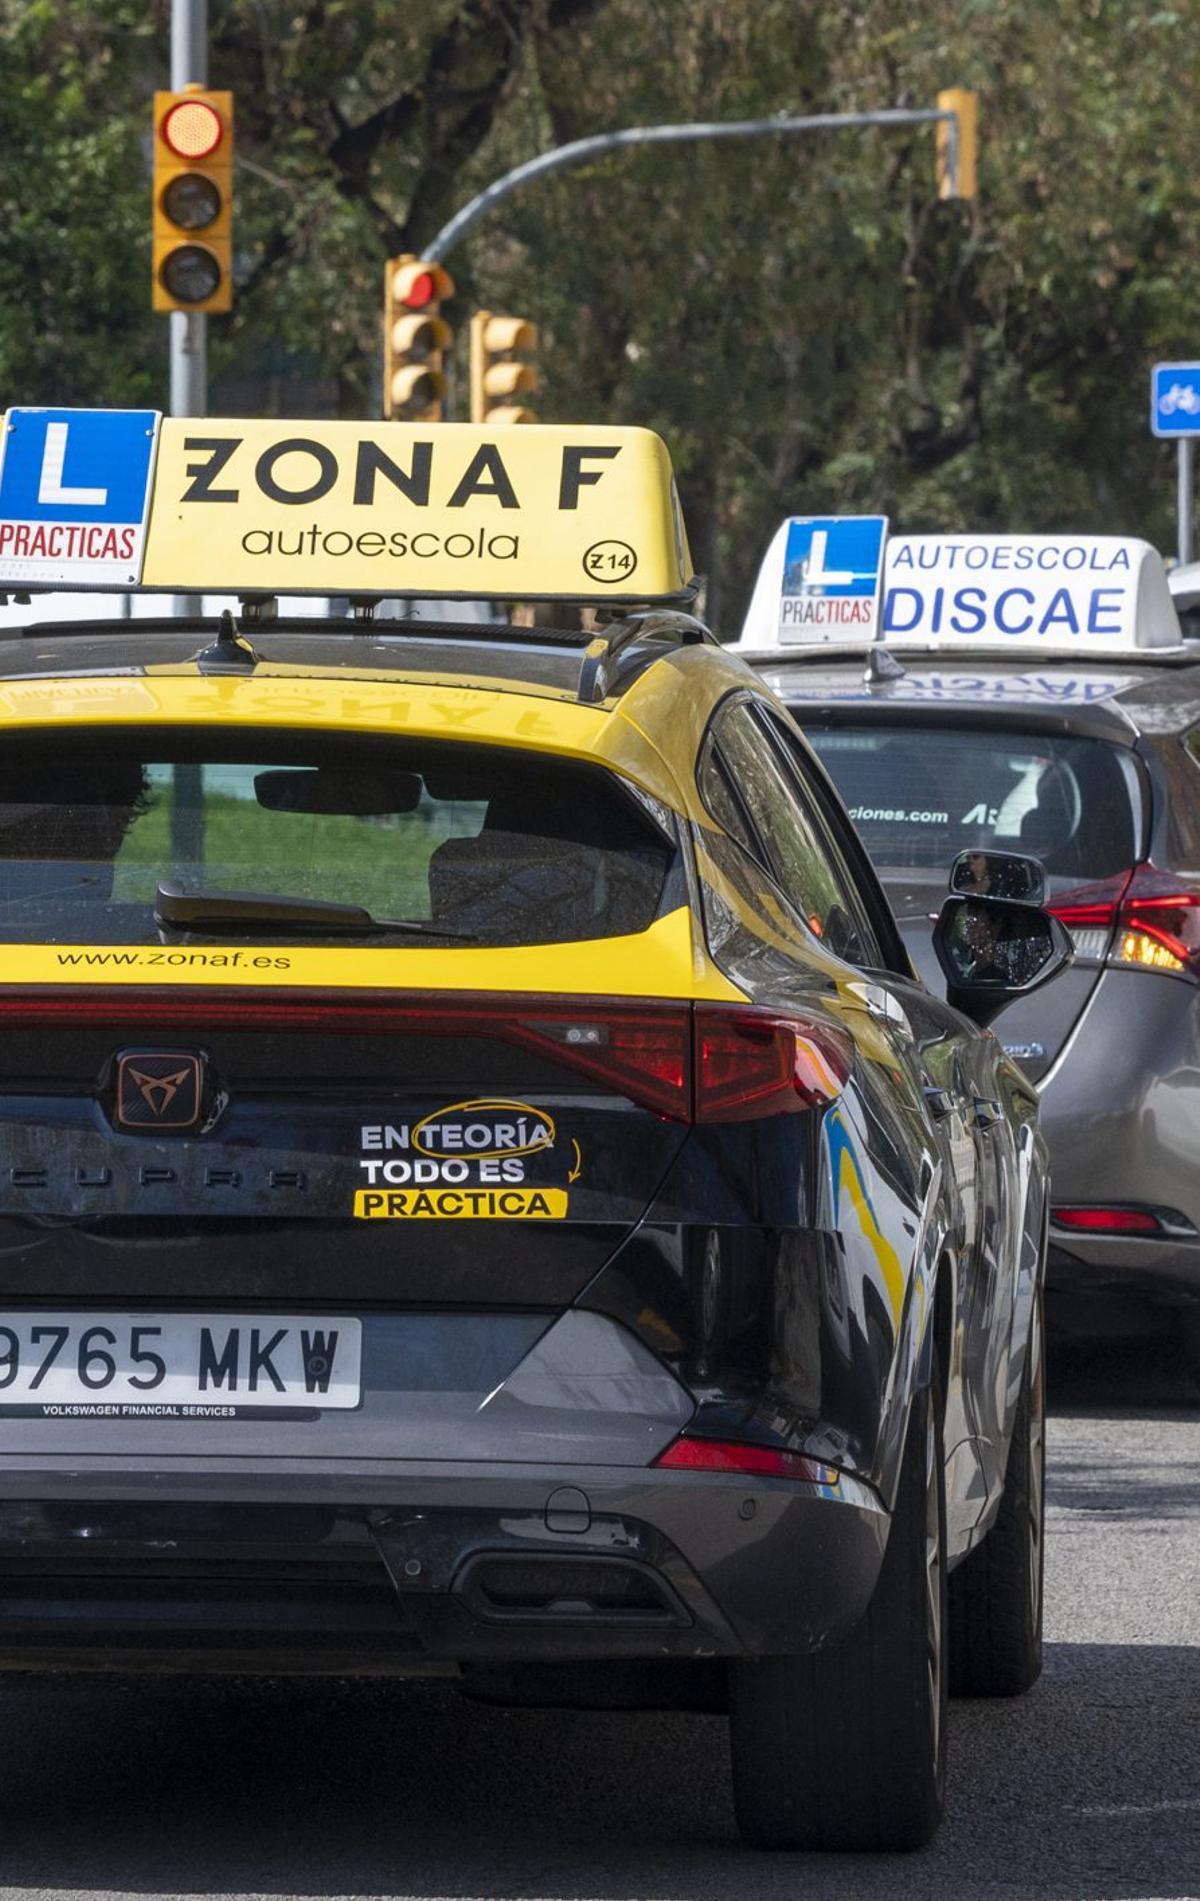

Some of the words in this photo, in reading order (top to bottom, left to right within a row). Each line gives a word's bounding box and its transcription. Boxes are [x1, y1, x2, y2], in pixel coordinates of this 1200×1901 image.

[38, 422, 108, 506] L
[558, 445, 622, 510] F
[0, 524, 136, 560] PRACTICAS
[241, 524, 520, 562] autoescola
[802, 530, 854, 586] L
[892, 544, 1130, 571] AUTOESCOLA
[782, 600, 872, 623] PRACTICAS
[883, 587, 1125, 634] DISCAE
[57, 951, 292, 970] www.zonaf.es
[362, 1125, 409, 1150] EN
[420, 1117, 554, 1149] TEORÍA
[360, 1159, 469, 1184] TODO
[479, 1158, 525, 1183] ES
[363, 1189, 552, 1216] PRÁCTICA
[199, 1328, 339, 1393] MKW
[43, 1405, 120, 1416] VOLKSWAGEN
[122, 1405, 180, 1416] FINANCIAL
[182, 1406, 236, 1417] SERVICES
